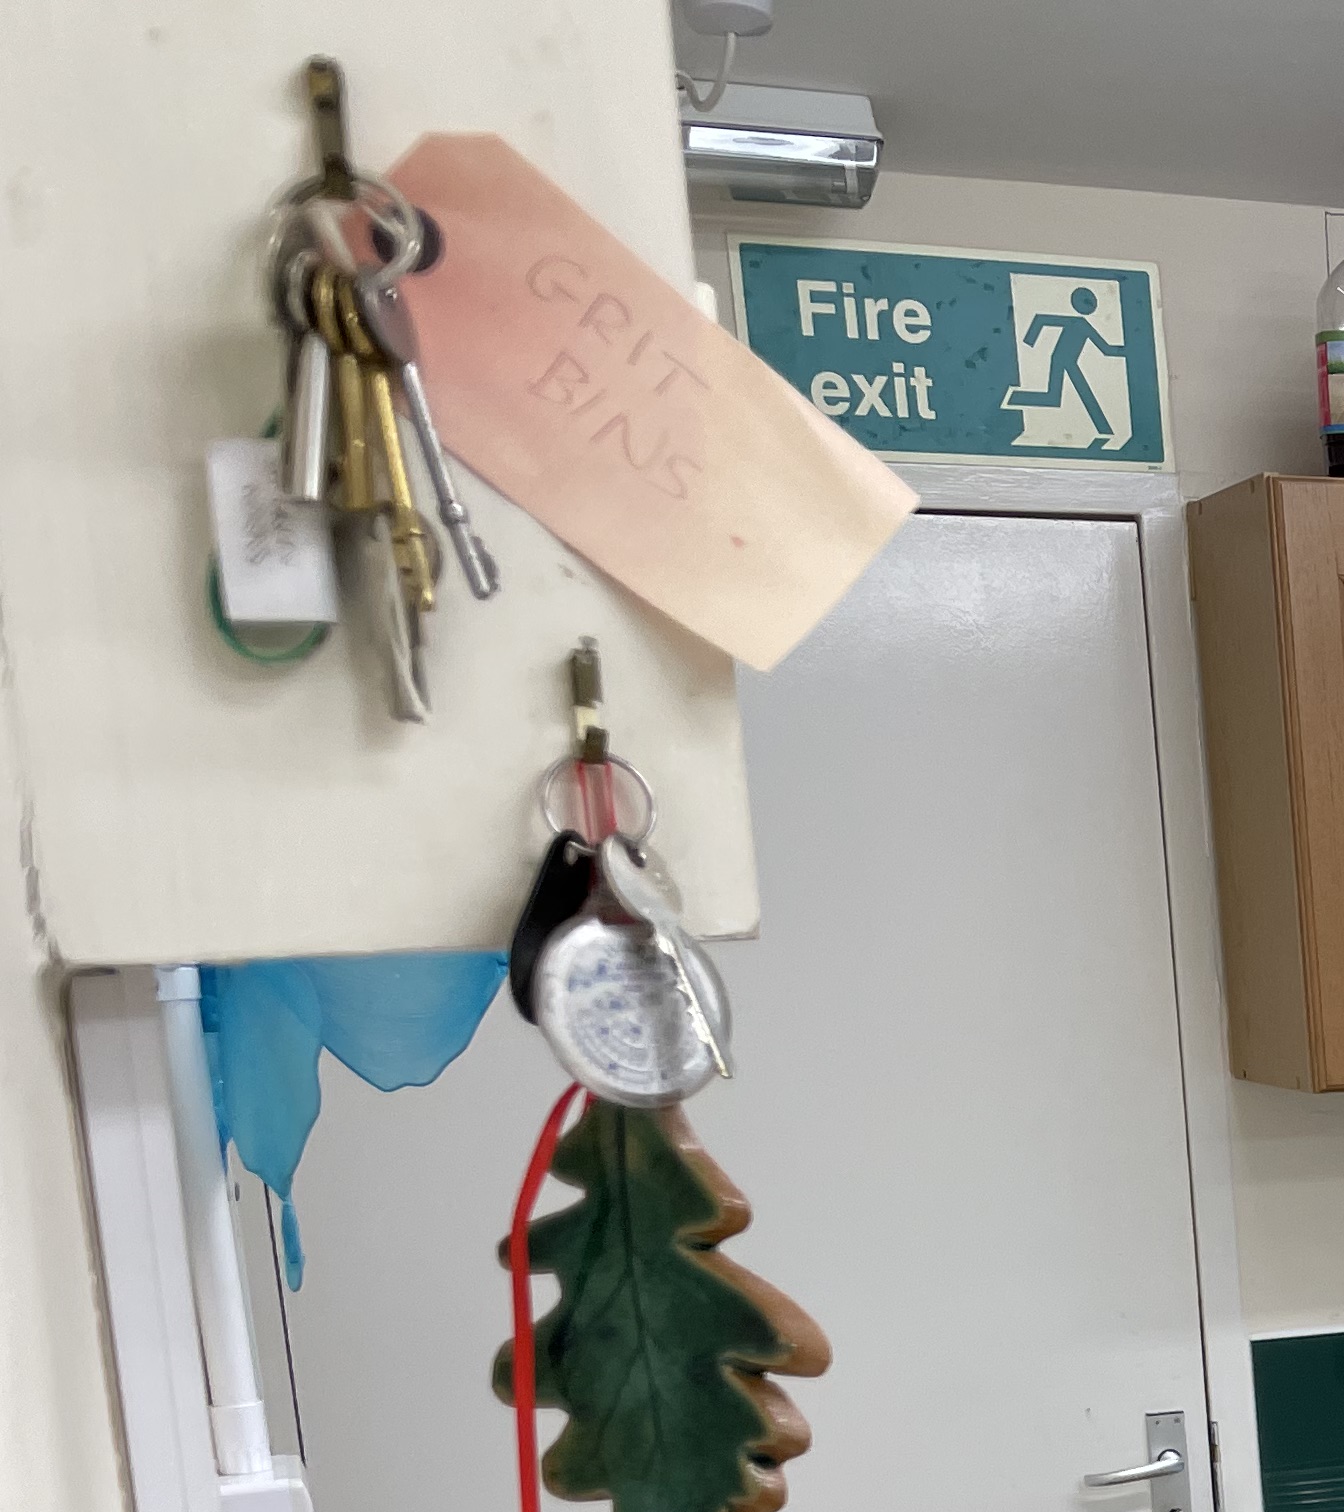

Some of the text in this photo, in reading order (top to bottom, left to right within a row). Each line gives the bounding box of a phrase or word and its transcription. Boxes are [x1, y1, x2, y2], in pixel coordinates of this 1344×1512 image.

[527, 254, 712, 400] GRIT
[796, 278, 932, 344] Fire
[527, 351, 704, 501] BINS
[809, 362, 937, 420] exit
